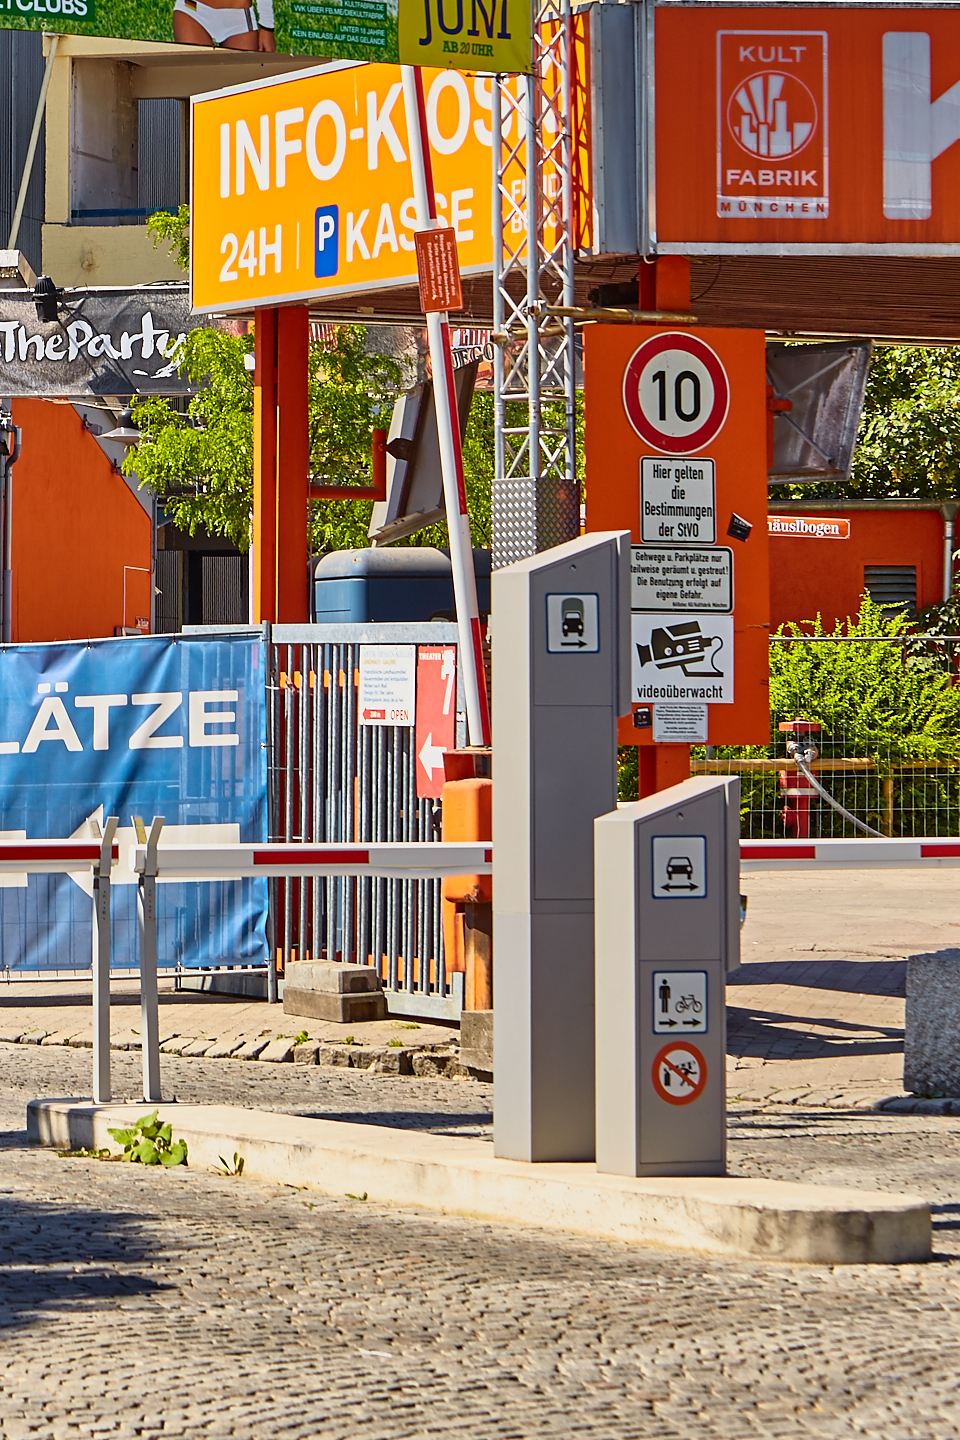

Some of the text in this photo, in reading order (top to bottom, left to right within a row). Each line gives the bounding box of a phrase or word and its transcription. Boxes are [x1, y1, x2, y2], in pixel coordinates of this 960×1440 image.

[307, 4, 325, 14] ÜBER
[344, 0, 385, 11] KULTFABRIK.DE
[292, 30, 386, 45] KEIN EINLASS AUF DAS GELÄNDE
[340, 25, 359, 34] UNTER
[366, 28, 385, 36] JAHRE
[442, 41, 494, 57] AB 20 UHR
[739, 46, 807, 63] KULT
[726, 169, 819, 187] FABRIK
[720, 200, 825, 213] MÜNCHEN
[219, 223, 283, 283] 24H
[318, 215, 335, 252] P
[652, 370, 701, 422] 10
[653, 463, 704, 483] Hier gelten
[671, 485, 685, 500] die
[644, 500, 713, 521] Bestimmungen
[658, 522, 699, 538] der StVO
[635, 551, 666, 564] Gehwege
[674, 552, 709, 564] Parkplätze
[711, 555, 723, 563] nur
[630, 564, 660, 574] teilweise
[661, 564, 690, 576] geräumt
[698, 565, 729, 576] gestreut!
[637, 576, 722, 589] Die Benutzung erfolgt auf
[656, 589, 704, 601] eigene Gefahr.
[637, 684, 724, 699] videoüberwacht
[390, 709, 409, 721] OPEN
